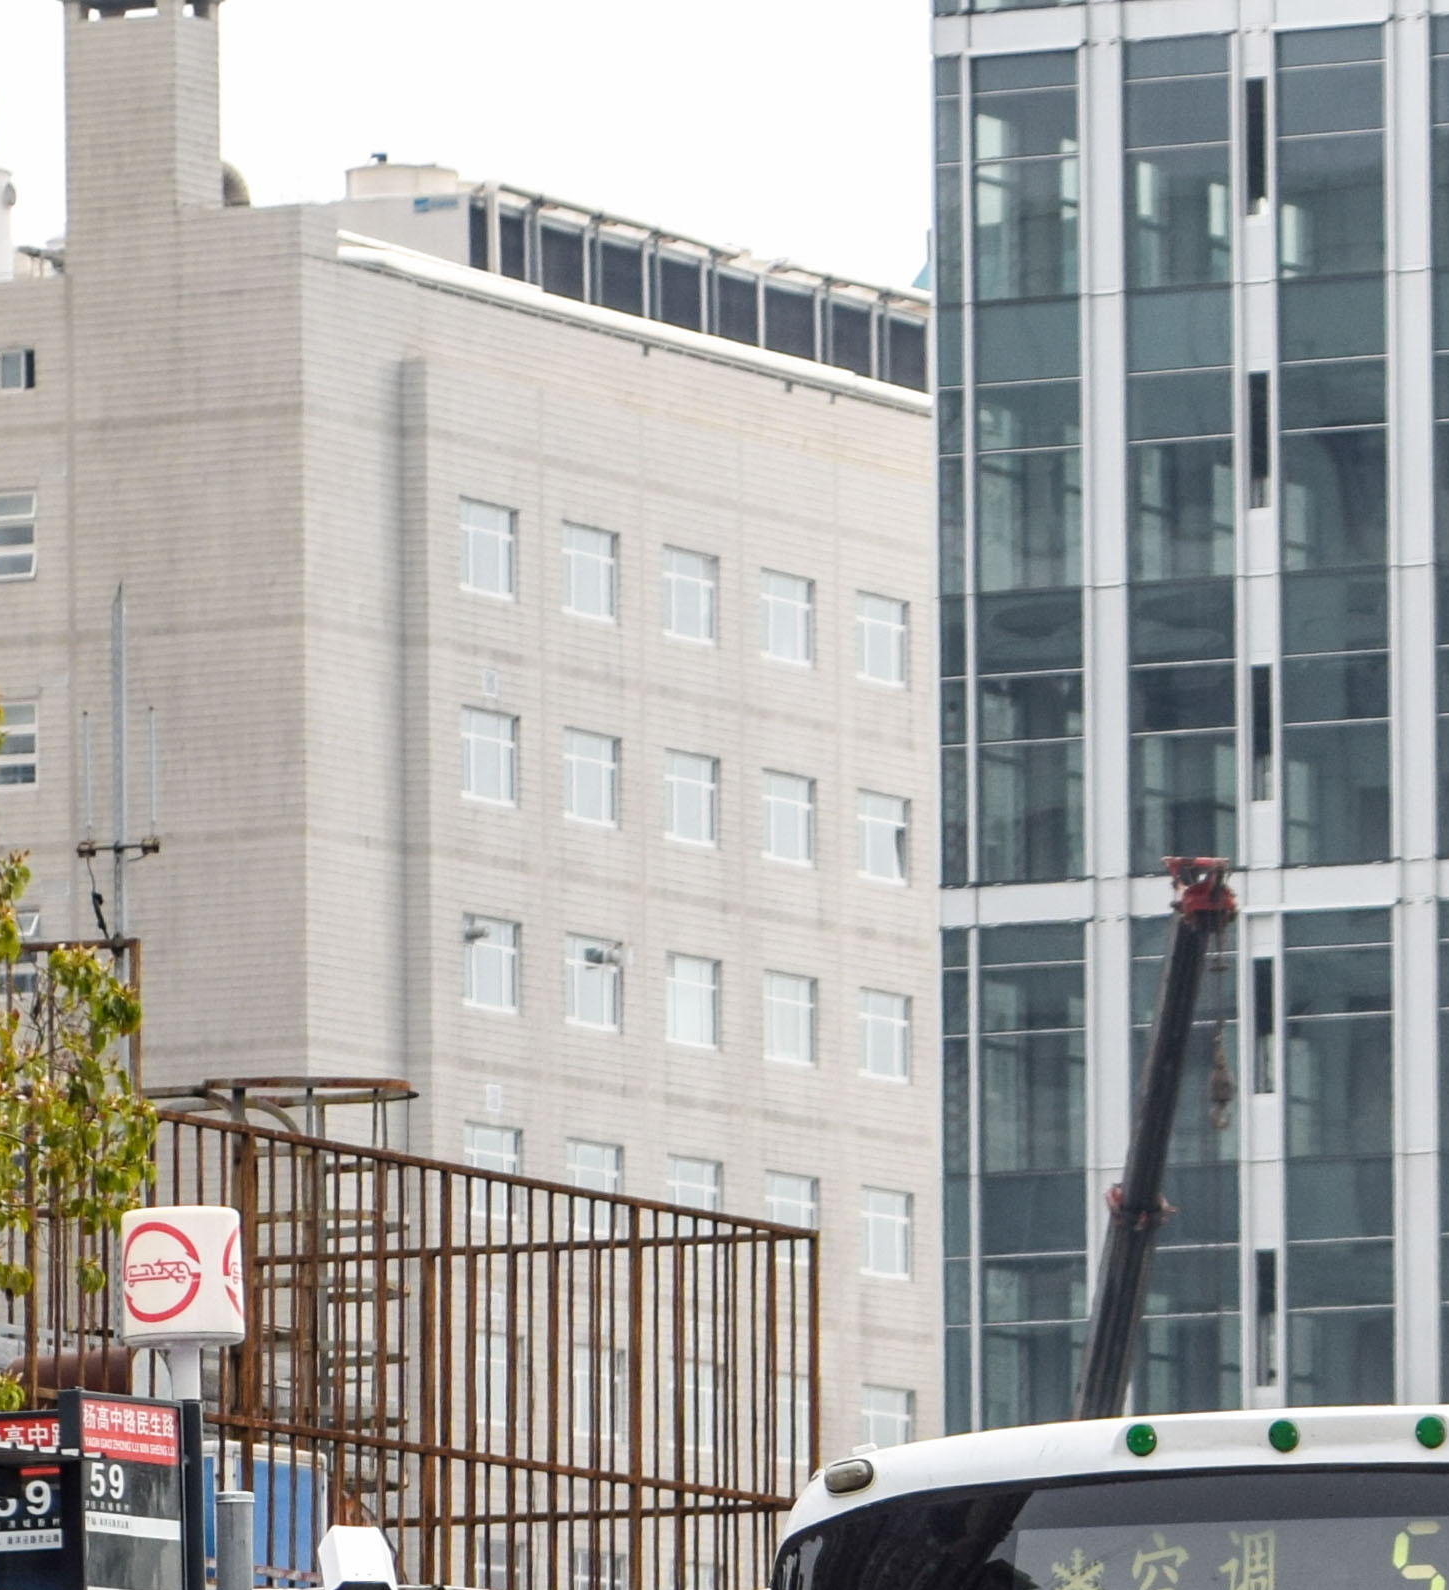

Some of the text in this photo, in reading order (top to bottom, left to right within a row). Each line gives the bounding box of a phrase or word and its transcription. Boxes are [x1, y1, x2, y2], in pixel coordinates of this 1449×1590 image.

[82, 1403, 176, 1439] 杨高中路民生路
[89, 1462, 125, 1500] 59
